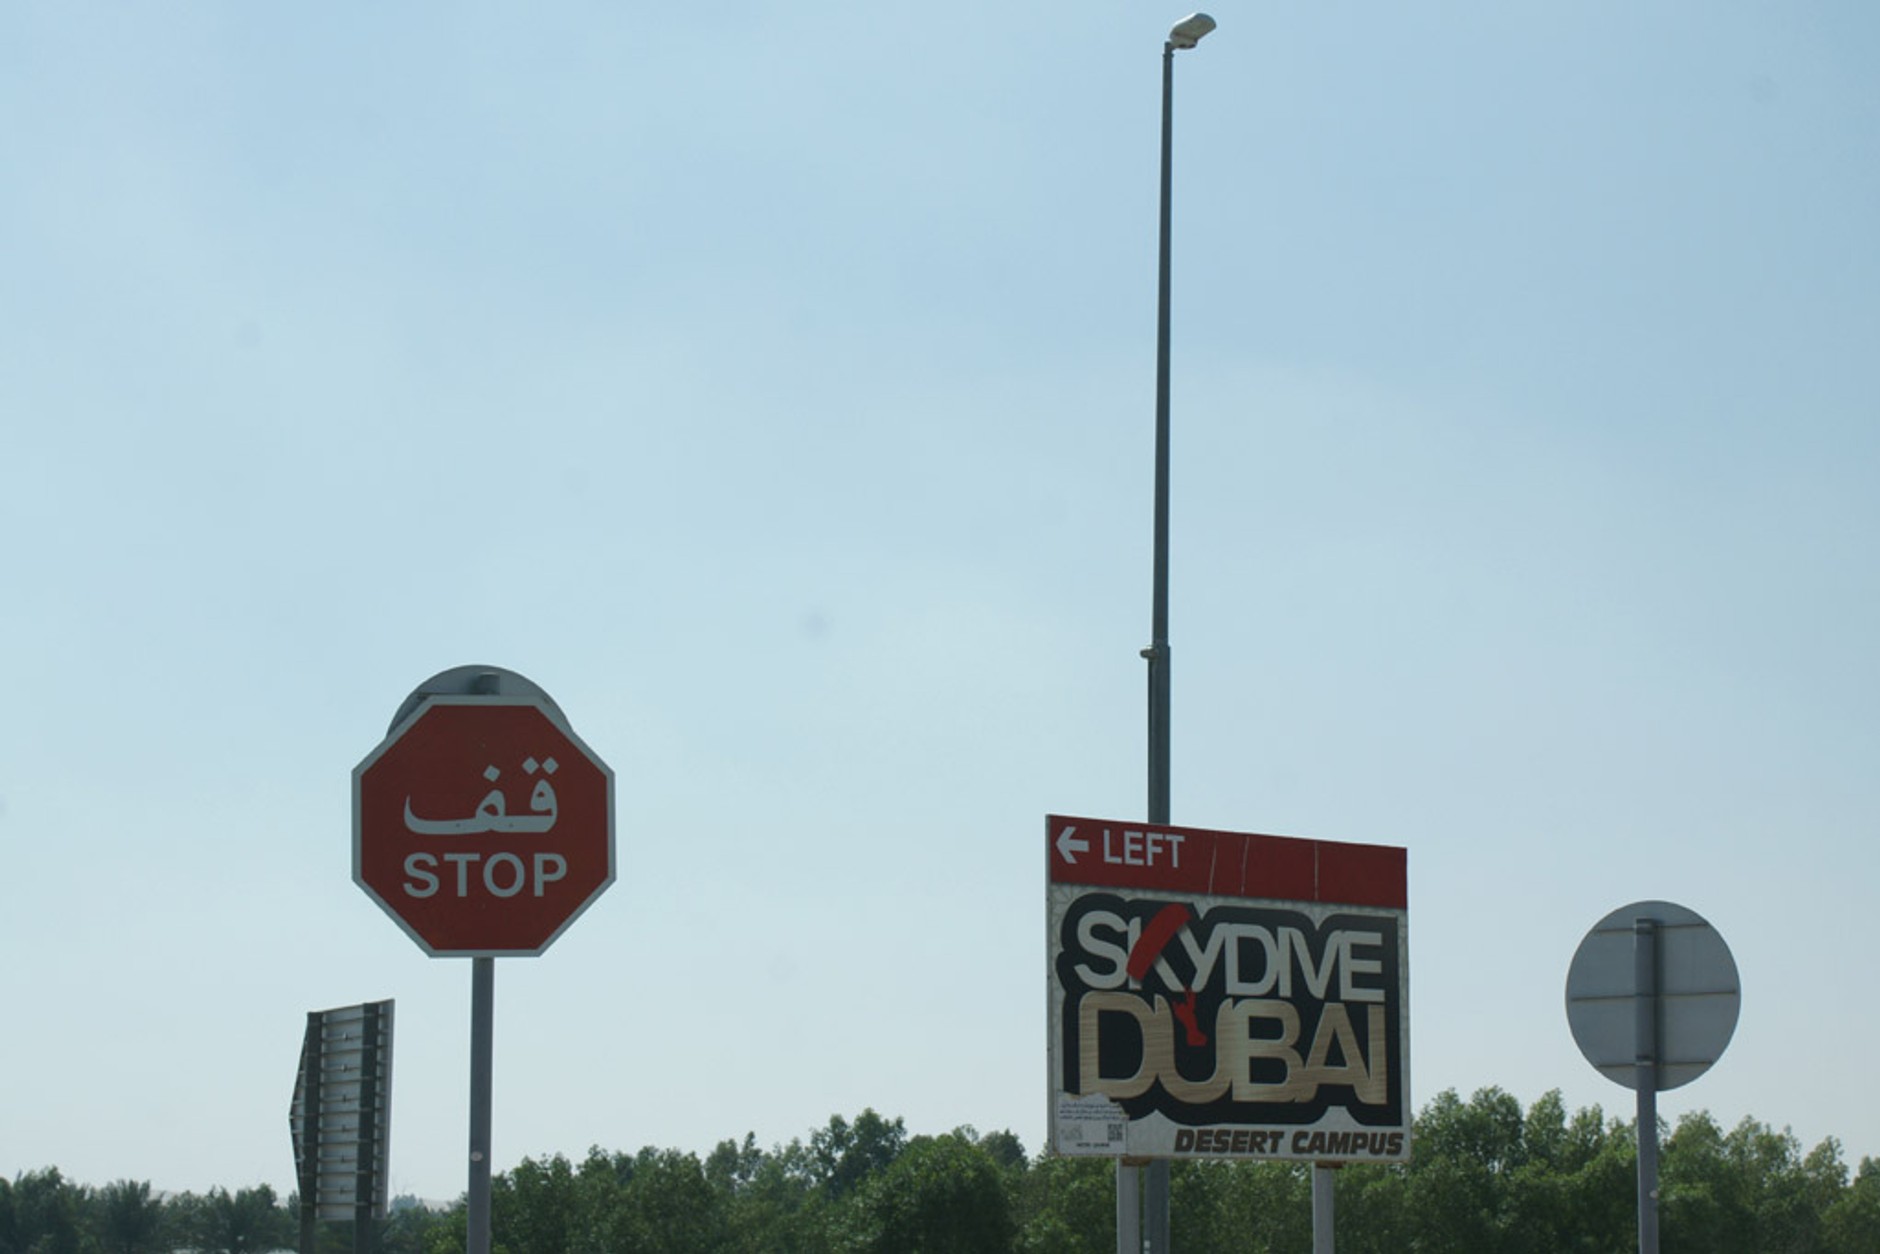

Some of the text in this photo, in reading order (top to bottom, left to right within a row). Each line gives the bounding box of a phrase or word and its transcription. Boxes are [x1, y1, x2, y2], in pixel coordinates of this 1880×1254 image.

[403, 756, 559, 835] قف
[402, 852, 568, 898] STOP
[1103, 829, 1185, 868] LEFT
[1074, 909, 1386, 1002] SKYDIVE
[1079, 991, 1387, 1105] DUBAI
[1174, 1128, 1404, 1155] DESERT CAMPUS
